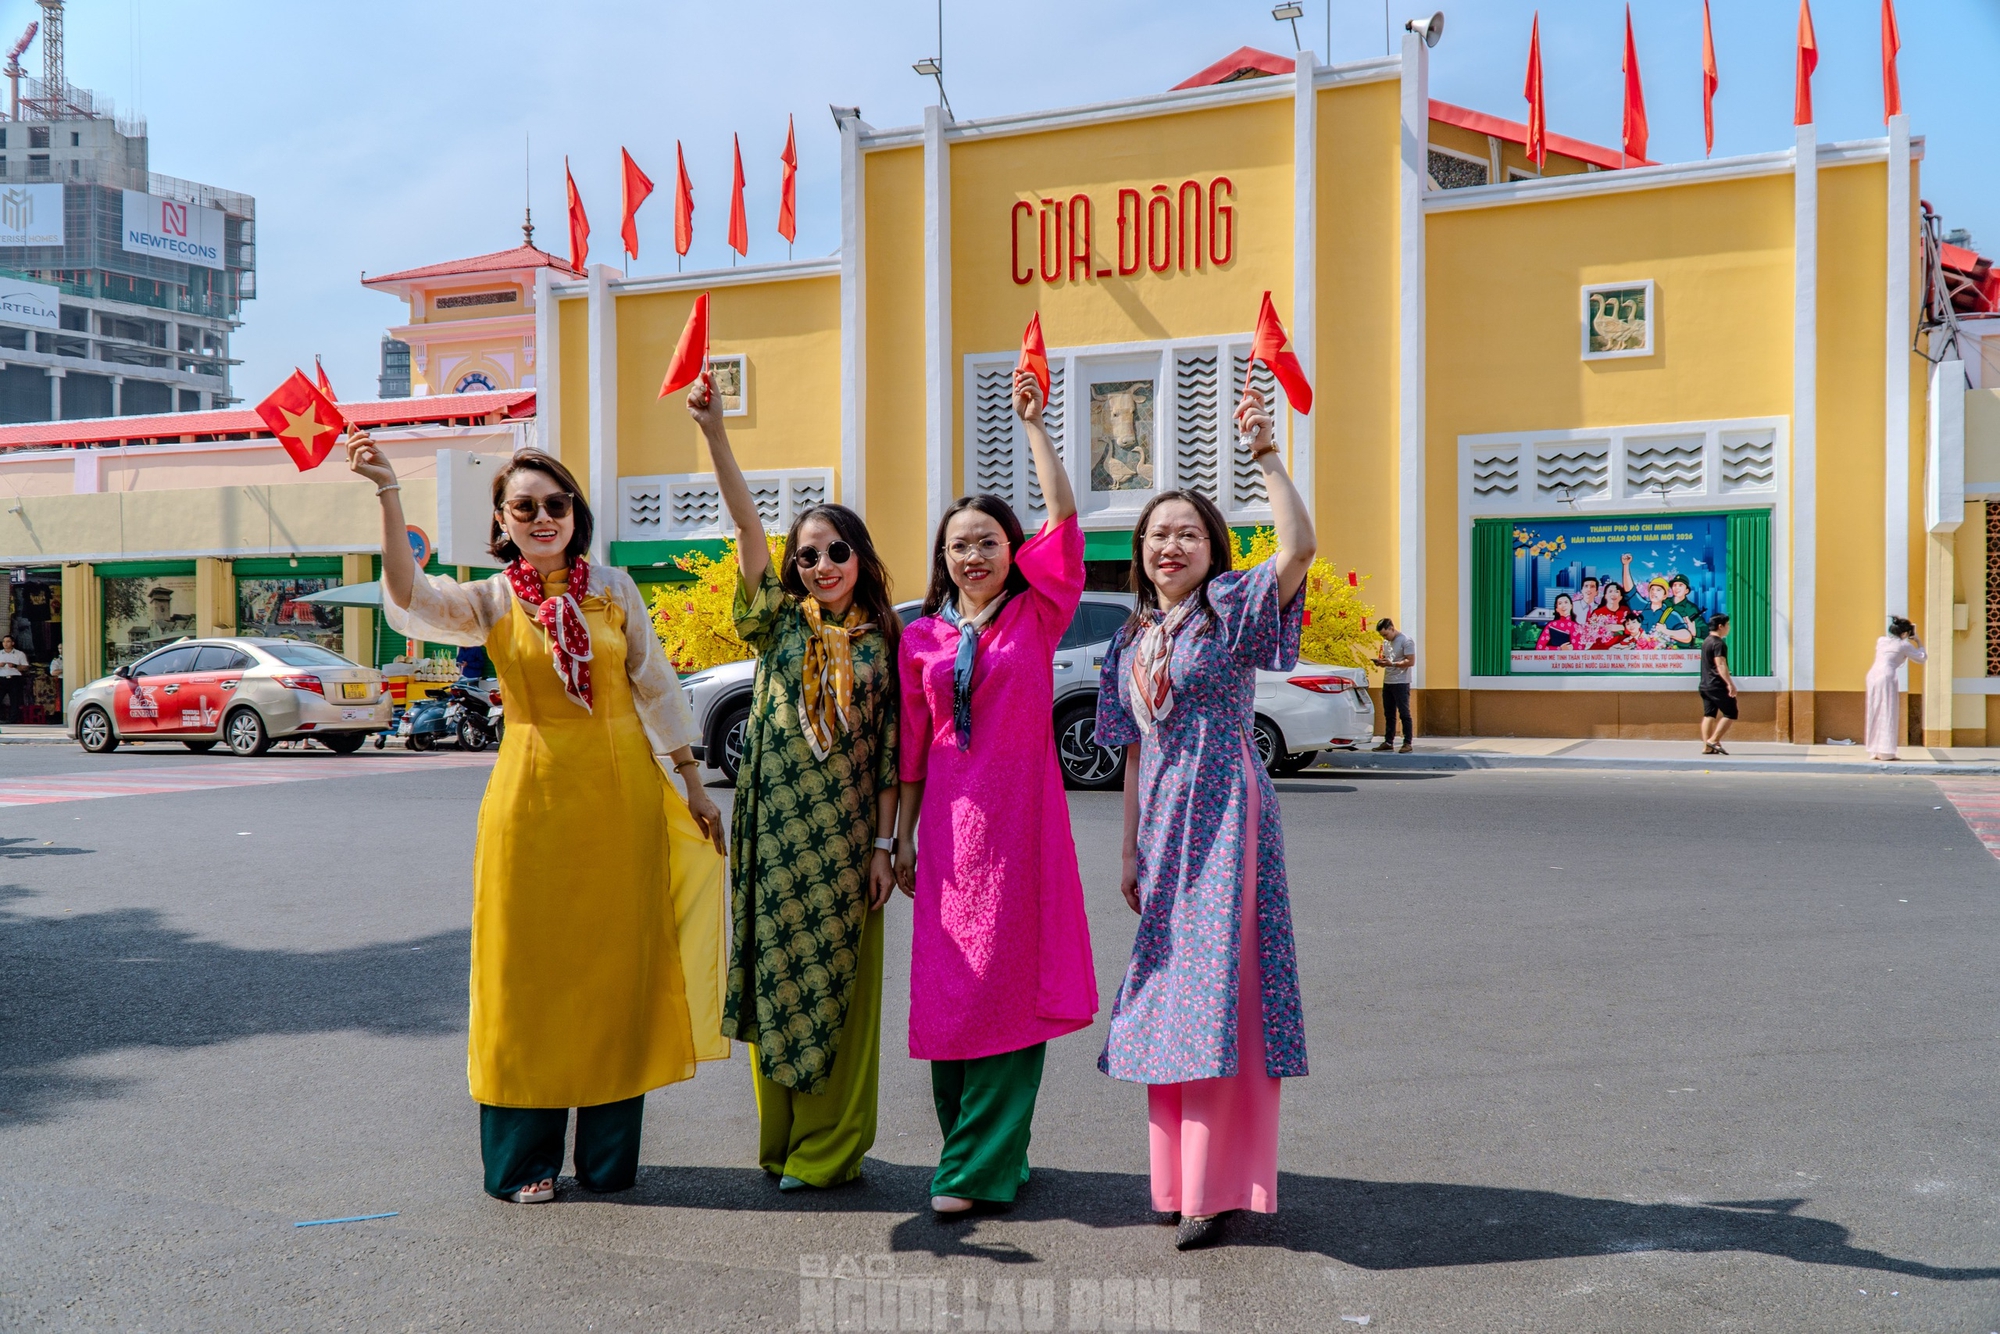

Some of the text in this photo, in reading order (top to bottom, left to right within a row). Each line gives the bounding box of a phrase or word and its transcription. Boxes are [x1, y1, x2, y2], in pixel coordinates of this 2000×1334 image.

[0, 234, 59, 243] ERISE HOMES
[129, 230, 217, 259] NEWTECONS
[0, 302, 57, 319] RTELIA
[1654, 523, 1673, 531] MINH
[1676, 533, 1693, 541] 2026
[129, 709, 159, 719] GENERALI
